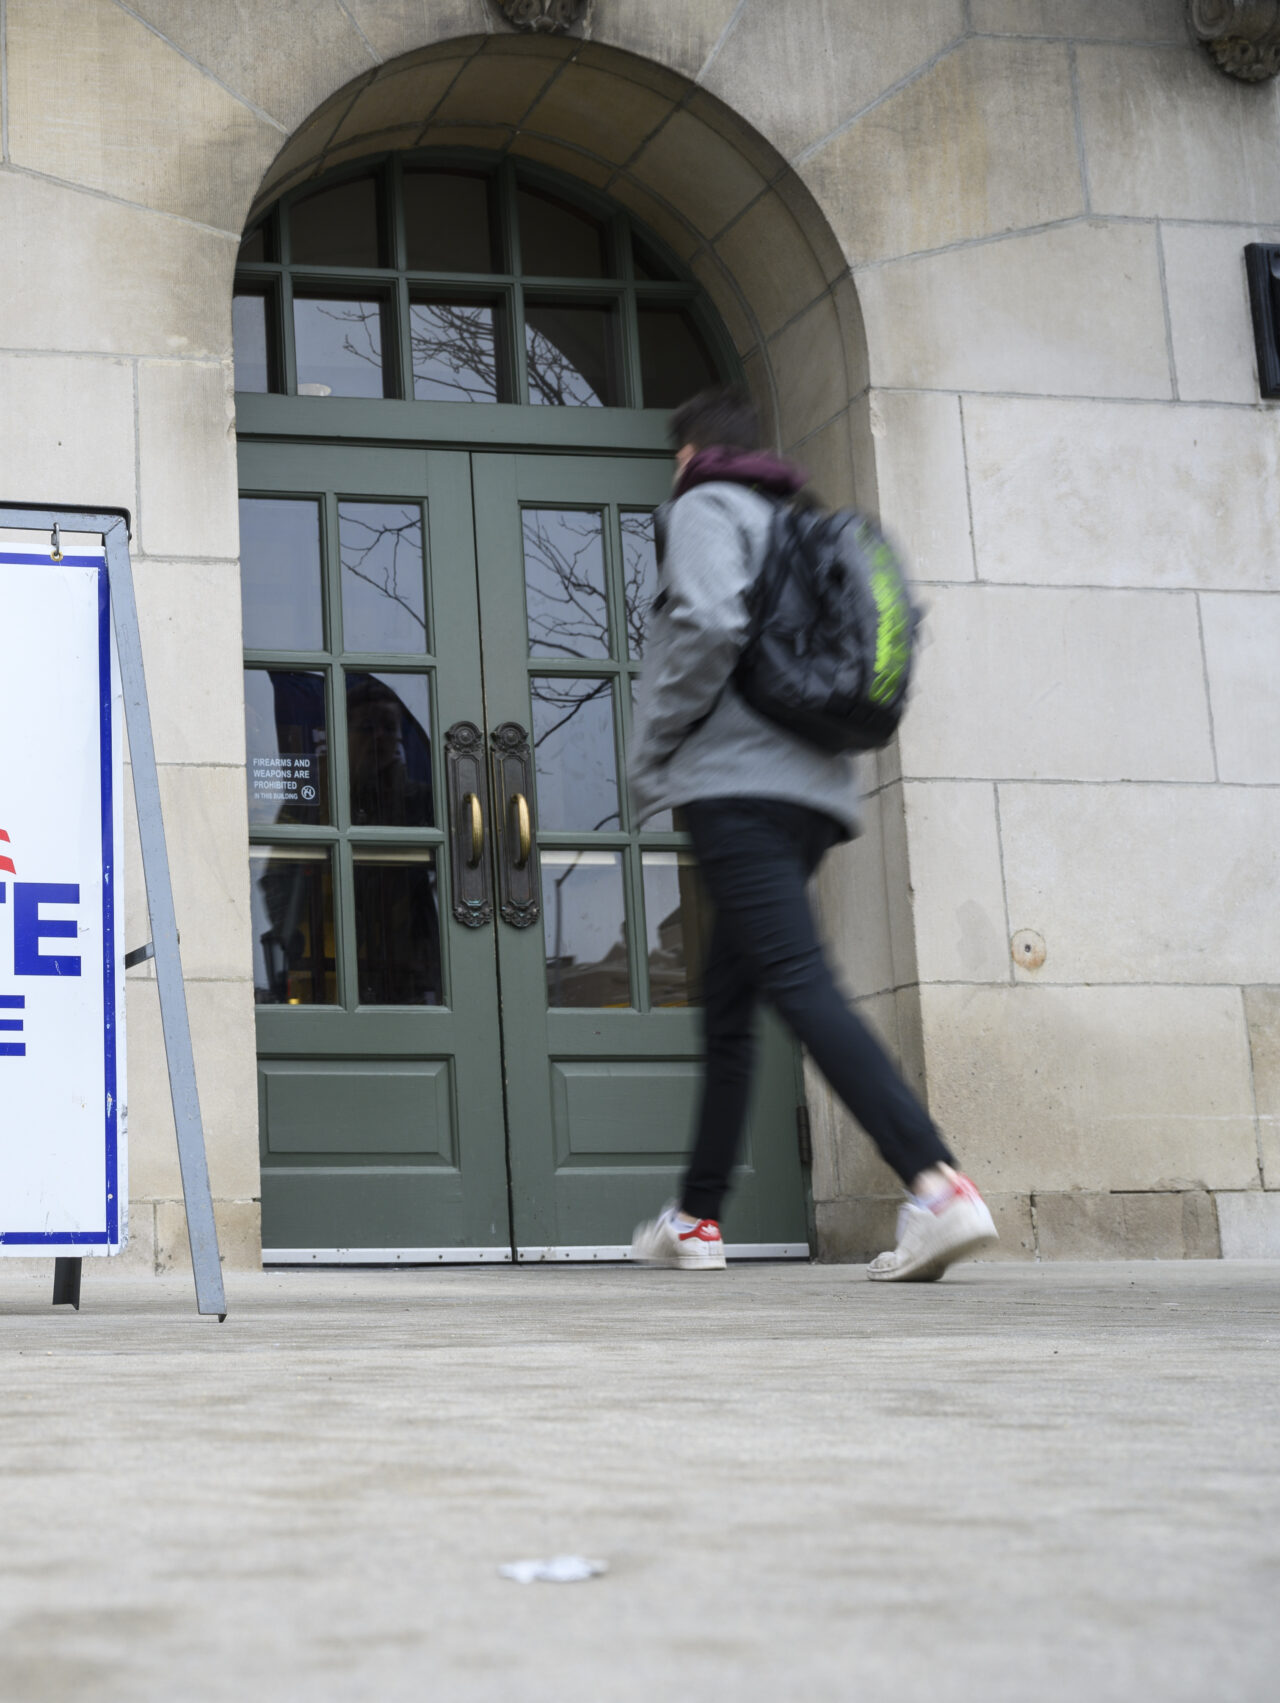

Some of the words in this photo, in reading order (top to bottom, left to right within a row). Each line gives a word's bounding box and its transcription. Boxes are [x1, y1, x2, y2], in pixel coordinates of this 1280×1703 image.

[253, 758, 292, 767] FIREARMS
[294, 759, 311, 767] AND
[253, 769, 292, 778] WEAPONS
[294, 770, 310, 779] ARE
[254, 781, 297, 789] PROHIBITED
